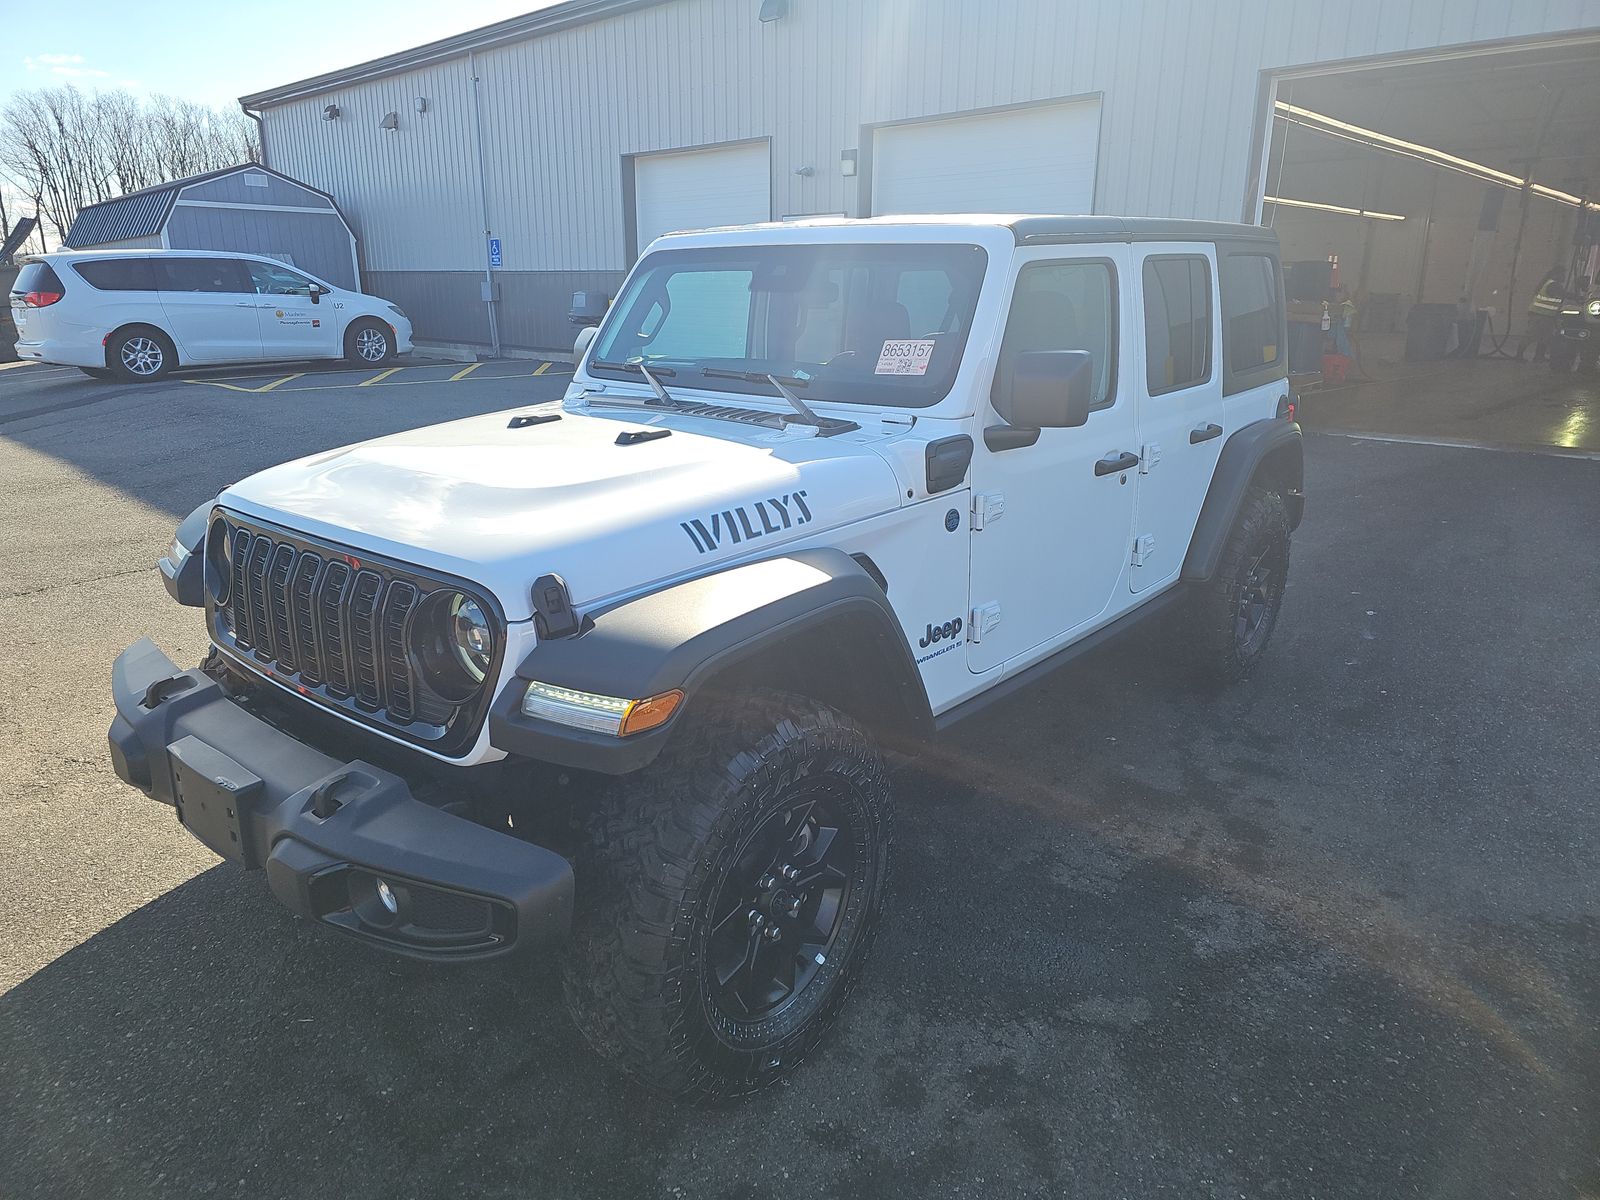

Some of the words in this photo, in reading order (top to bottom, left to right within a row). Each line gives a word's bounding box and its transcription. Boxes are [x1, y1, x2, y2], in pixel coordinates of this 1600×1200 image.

[882, 343, 934, 357] 8653157
[680, 490, 812, 554] WILLYS
[919, 617, 962, 648] Jeep
[916, 644, 955, 664] WRANGLER
